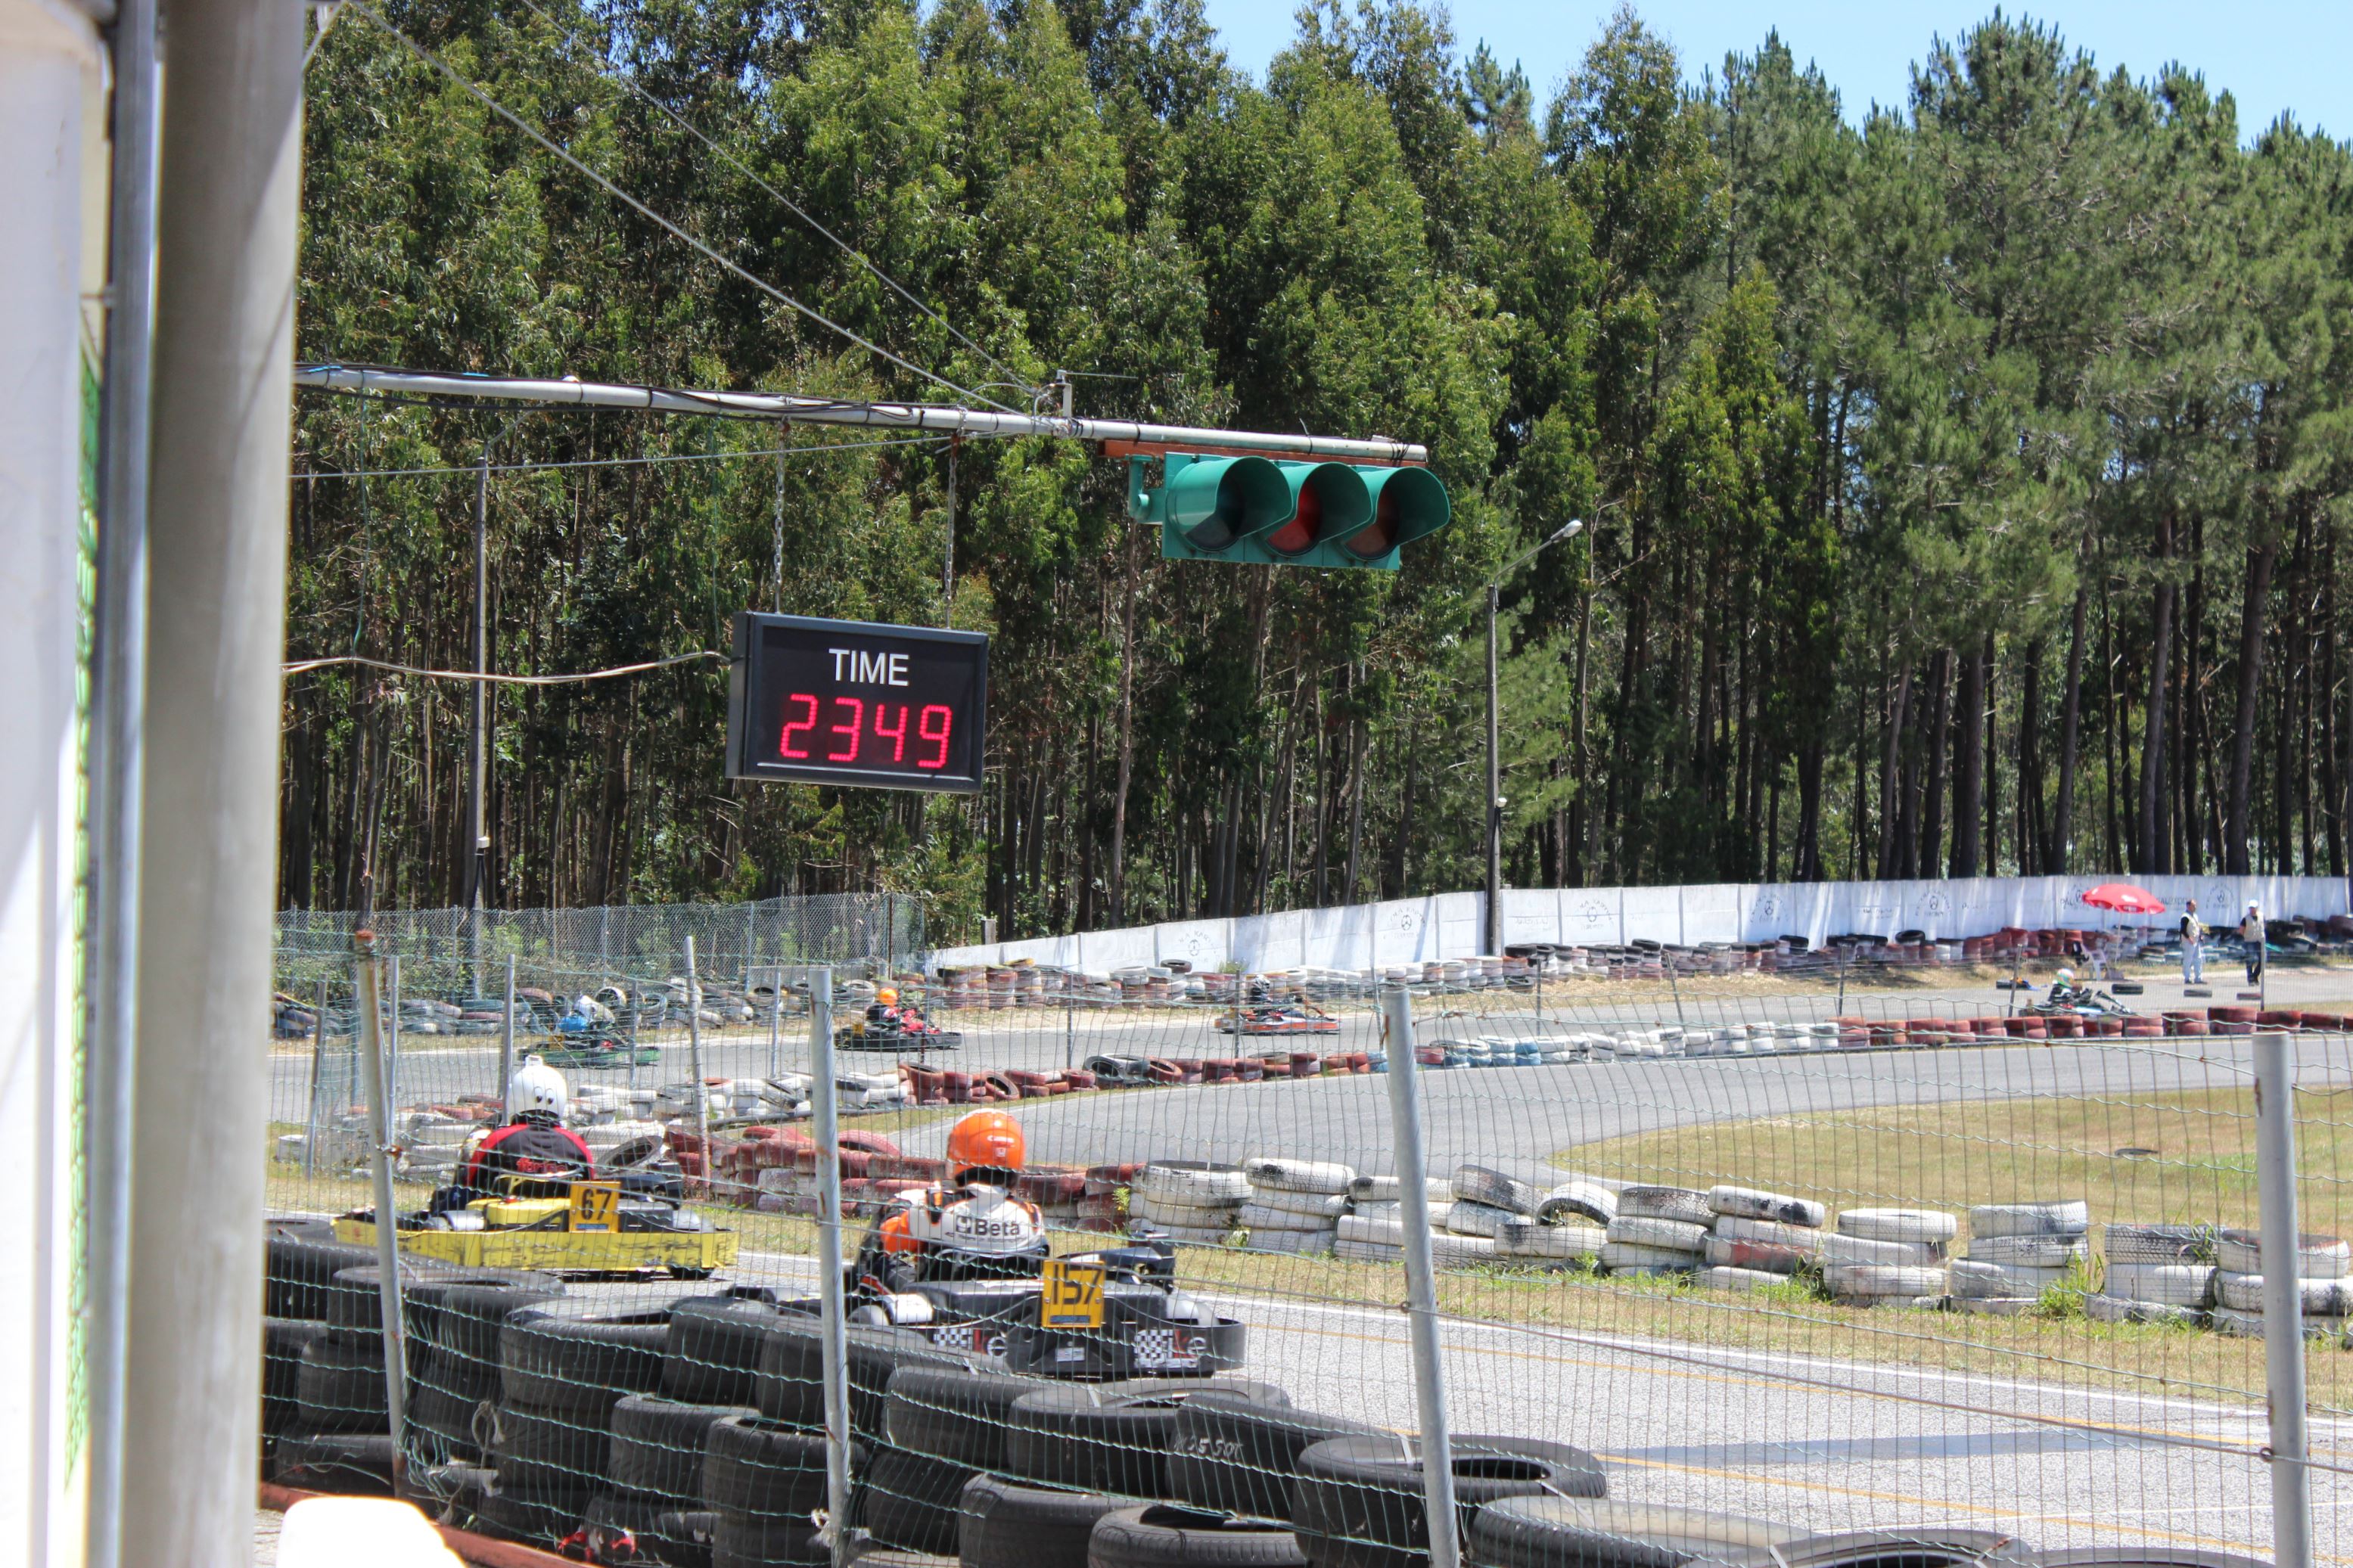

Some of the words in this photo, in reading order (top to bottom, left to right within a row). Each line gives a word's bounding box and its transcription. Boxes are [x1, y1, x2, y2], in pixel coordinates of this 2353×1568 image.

[828, 648, 909, 686] TIME
[779, 693, 953, 768] 2349
[581, 1188, 611, 1221] 67
[975, 1218, 1020, 1236] Beta
[1053, 1263, 1103, 1306] 157
